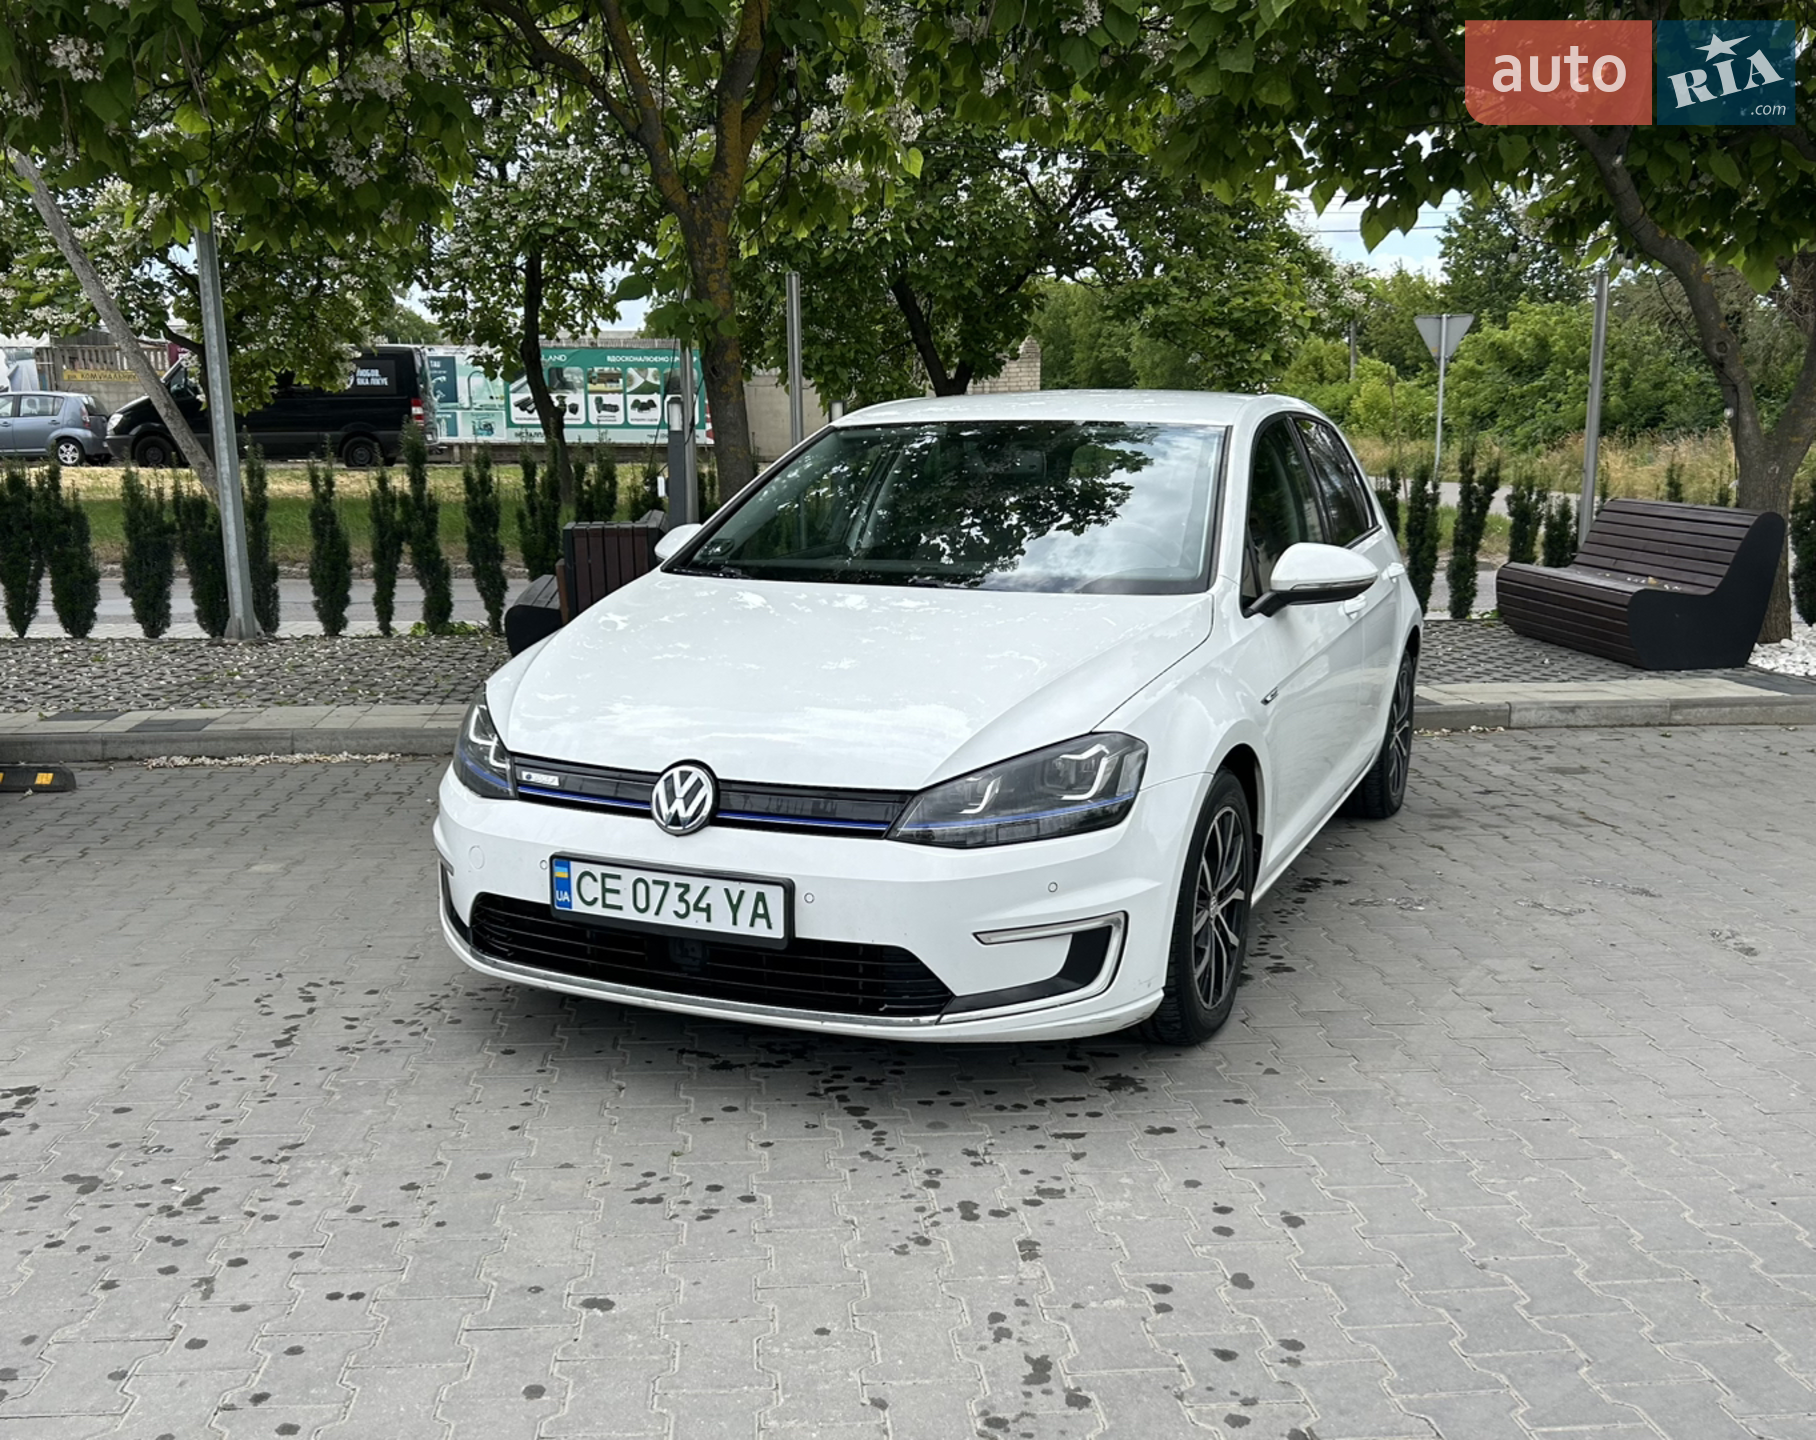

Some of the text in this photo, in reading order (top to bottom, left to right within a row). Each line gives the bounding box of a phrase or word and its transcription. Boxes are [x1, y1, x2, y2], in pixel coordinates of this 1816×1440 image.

[555, 890, 571, 903] UA
[576, 870, 773, 930] CE 0734 YA
